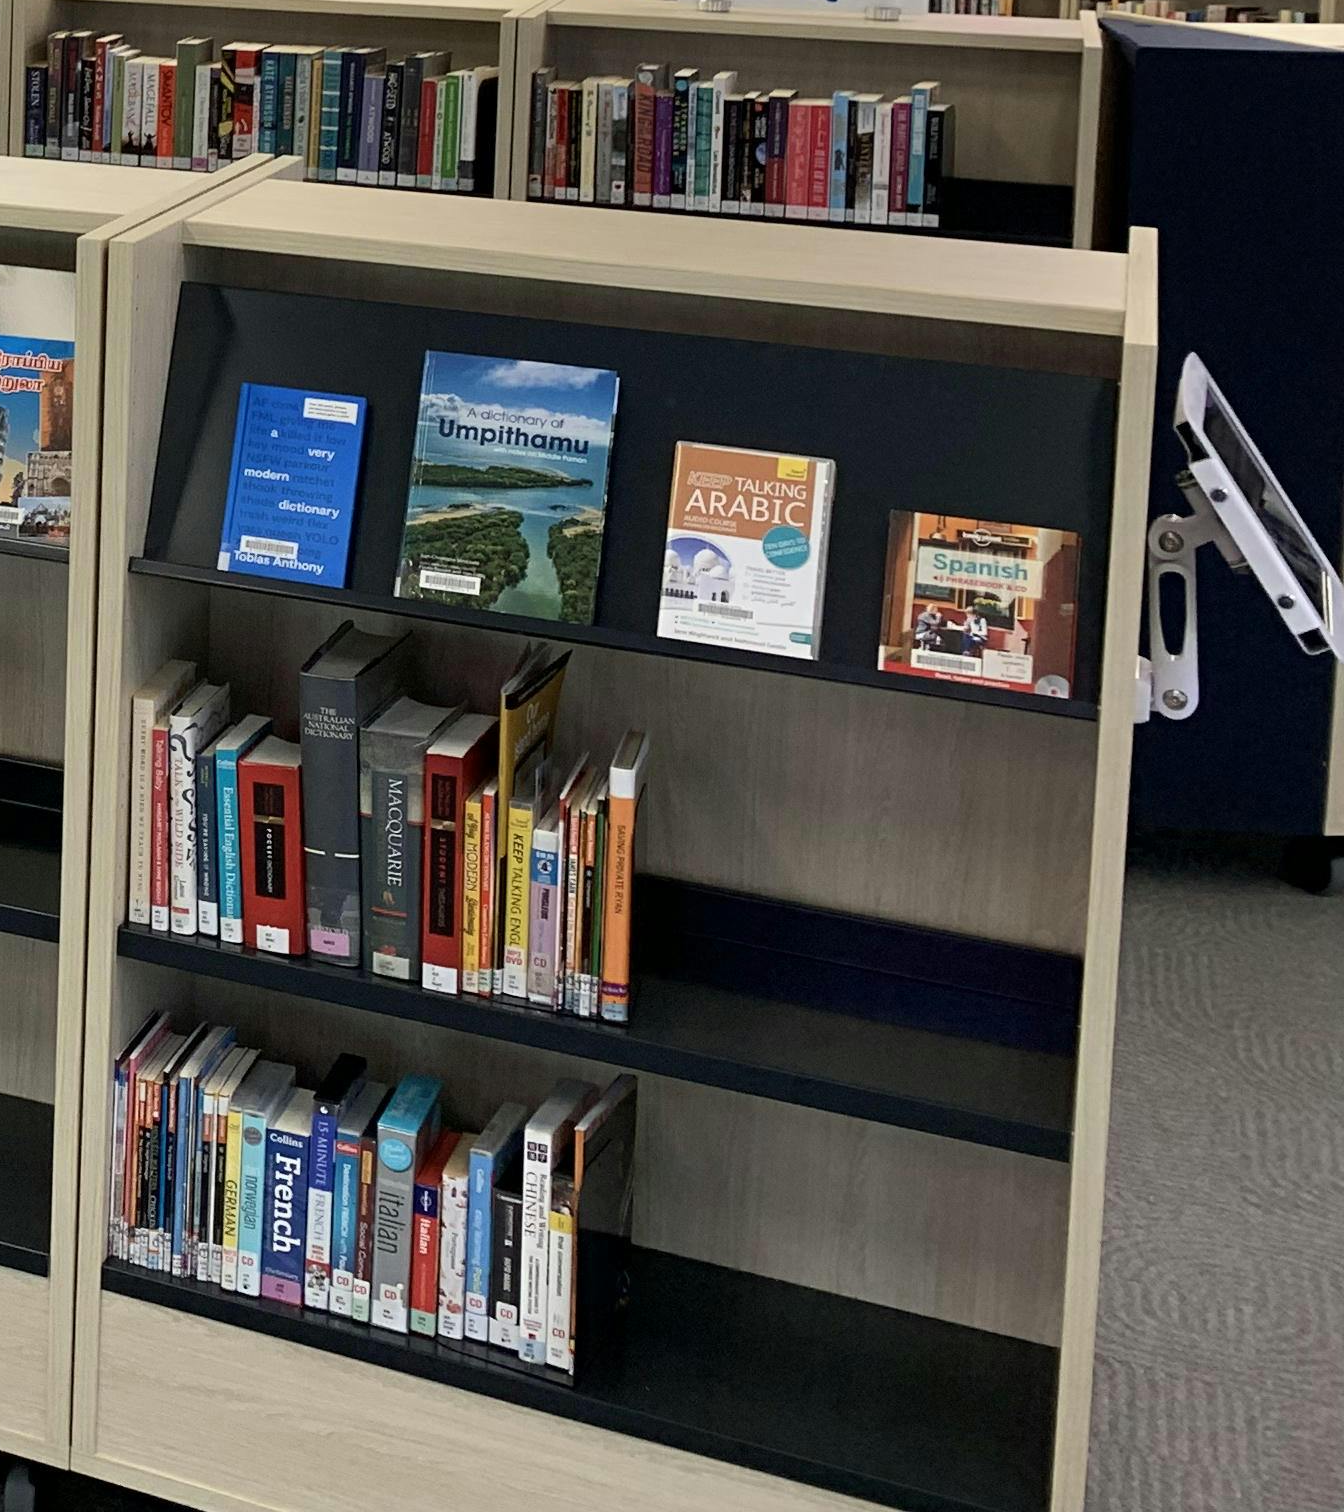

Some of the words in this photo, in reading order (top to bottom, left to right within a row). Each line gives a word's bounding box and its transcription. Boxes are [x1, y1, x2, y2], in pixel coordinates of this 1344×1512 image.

[264, 59, 275, 81] KATE
[30, 70, 41, 106] STOLEN
[145, 73, 157, 126] MAGEFALL
[263, 84, 273, 127] ATKINSON
[367, 105, 375, 144] ATWOOD
[381, 131, 391, 165] ATWOOD
[466, 406, 477, 419] A
[480, 408, 547, 429] dictionary
[551, 417, 565, 429] of
[270, 429, 279, 438] a
[438, 418, 589, 456] Umpithamu
[307, 448, 335, 462] very
[244, 469, 290, 482] modern
[687, 470, 733, 490] KEEP
[734, 476, 808, 501] TALKING
[278, 500, 340, 520] dictionary
[684, 488, 807, 528] ARABIC
[234, 549, 271, 566] Tobias
[272, 556, 325, 575] Anthony
[765, 544, 808, 559] CONFIDENCE
[932, 552, 1029, 582] Spanish
[945, 576, 1005, 590] PHRASEBOOK
[1013, 585, 1028, 594] CD
[303, 712, 356, 726] AUSTRALIAN
[320, 706, 337, 716] THE
[304, 728, 353, 741] DICTIONARY
[308, 720, 348, 733] NATIONAL
[154, 739, 164, 768] Talking
[153, 769, 163, 790] Baby
[173, 757, 185, 788] TALK
[173, 808, 185, 839] WILD
[223, 786, 235, 831] Essential
[385, 778, 404, 887] MACQUARIE
[616, 824, 626, 853] SAVING
[173, 840, 185, 869] SIDE
[221, 832, 235, 868] English
[439, 837, 448, 886] STUDENT
[512, 833, 524, 865] KEEP
[265, 859, 275, 894] DICTIONARY
[466, 842, 479, 892] MODERN
[615, 854, 626, 890] PRIVATE
[223, 868, 237, 918] Dictionar
[511, 867, 523, 910] TALKING
[614, 891, 625, 914] RYAN
[510, 917, 522, 947] ENGL
[505, 957, 523, 966] DVD
[534, 957, 547, 968] CD
[270, 1132, 303, 1149] Collins
[313, 1120, 331, 1185] 15-MINUTE
[340, 1163, 353, 1206] Destination
[539, 1173, 548, 1203] Reading
[223, 1179, 238, 1237] GERMAN
[244, 1175, 260, 1230] norwegian
[271, 1152, 302, 1253] French
[313, 1192, 328, 1241] FRENCH
[523, 1171, 539, 1239] CHINESE
[538, 1204, 548, 1219] and
[340, 1206, 351, 1238] FRENCH
[359, 1221, 369, 1250] Social
[376, 1189, 406, 1255] italian
[417, 1218, 432, 1255] Italian
[536, 1221, 547, 1249] Writing
[241, 1256, 254, 1267] CD
[336, 1276, 349, 1287] CD
[354, 1285, 367, 1296] CD
[384, 1289, 397, 1301] CD
[468, 1297, 482, 1309] CD
[499, 1308, 513, 1320] CD
[551, 1327, 566, 1339] CD
